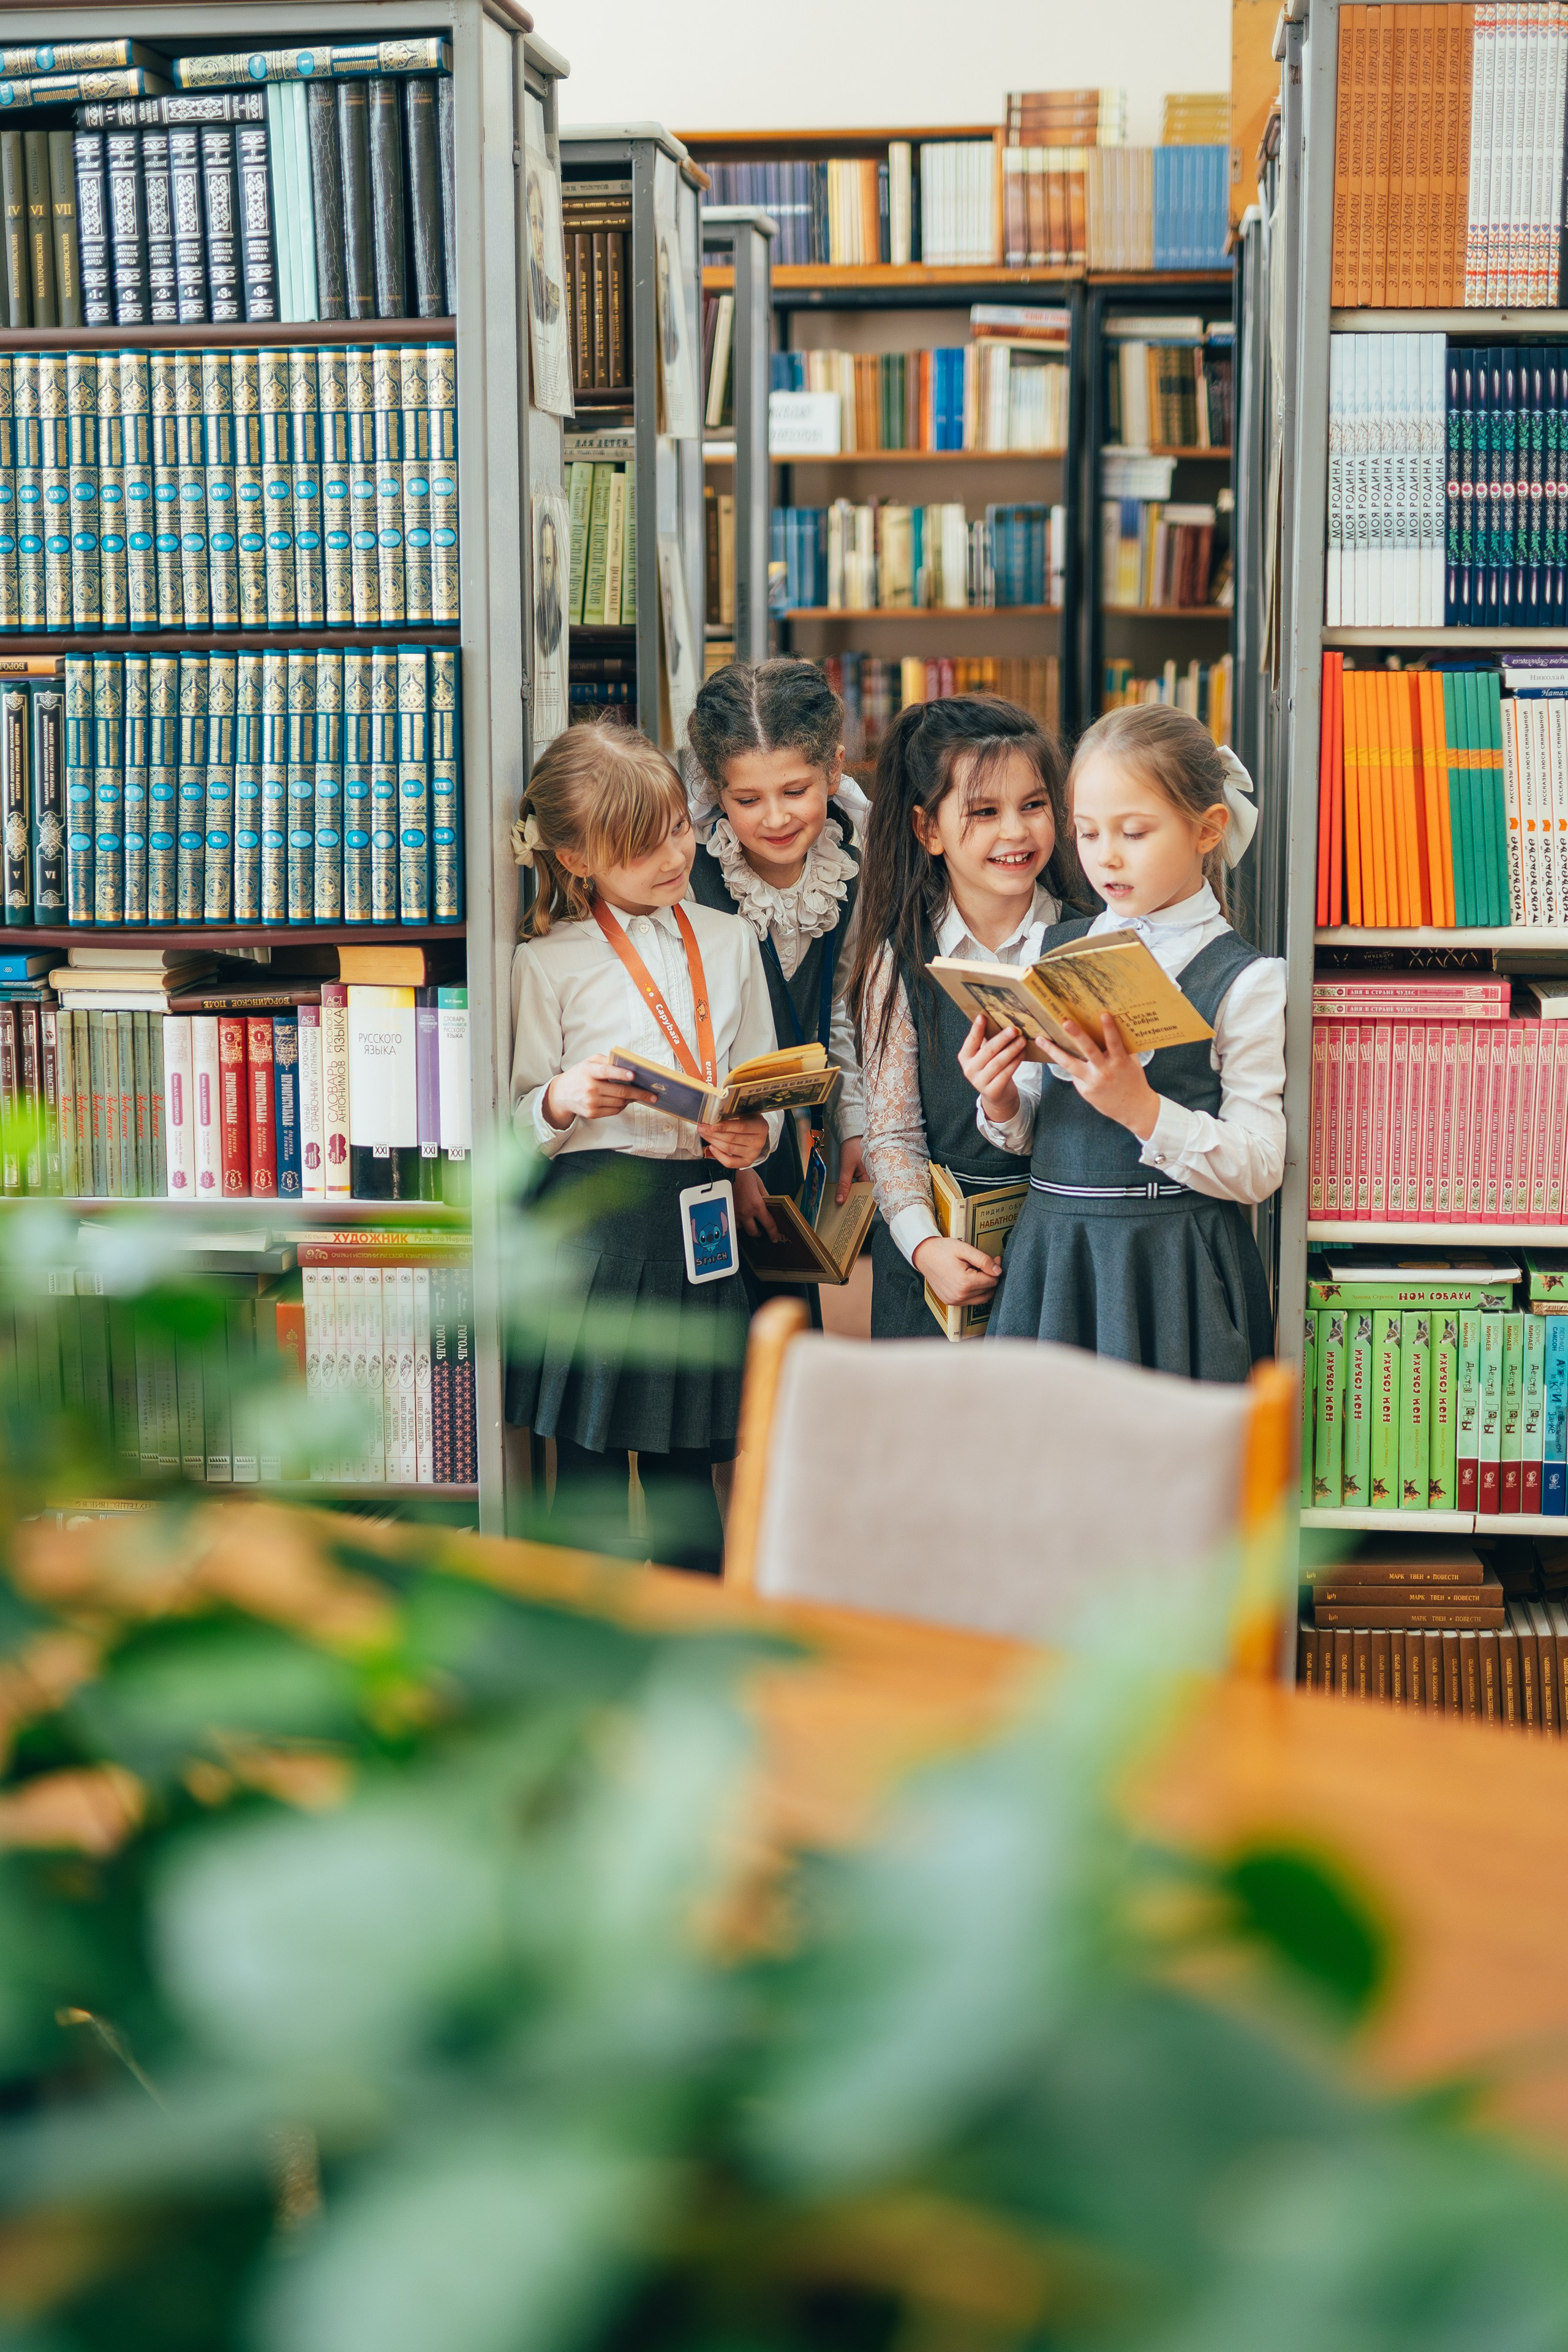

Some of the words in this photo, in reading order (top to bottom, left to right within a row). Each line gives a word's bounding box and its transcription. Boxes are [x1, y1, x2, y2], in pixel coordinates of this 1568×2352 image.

[1341, 28, 1352, 86] НЕВЕСТА
[1395, 28, 1405, 86] НЕВЕСТА
[1475, 49, 1483, 86] СКАЗКИ
[1473, 89, 1483, 149] ВОЛШЕБНЫЕ
[1338, 92, 1351, 178] КОРОЛЕВСКАЯ
[1392, 92, 1405, 178] КОРОЛЕВСКАЯ
[7, 205, 21, 216] IV
[31, 205, 43, 216] VI
[55, 204, 72, 215] VII
[1332, 459, 1342, 508] РОДИНА
[1359, 459, 1368, 509] РОДИНА
[1384, 458, 1393, 507] РОДИНА
[1332, 513, 1341, 538] МОЯ
[1384, 512, 1392, 537] МОЯ
[12, 870, 20, 879] V
[45, 870, 56, 879] VI
[203, 1000, 226, 1009] ПОЛЕ
[232, 996, 290, 1007] БОРОДИНСКОЕ
[334, 1008, 344, 1052] ЯЗЫКА
[359, 1033, 402, 1044] РУССКОГО
[655, 1003, 680, 1045] Capybara
[364, 1044, 396, 1055] ЯЗЫКА
[303, 1071, 309, 1081] ПО
[311, 1079, 319, 1132] СПРАВОЧНИК
[327, 1061, 338, 1123] СЛОВАРЬ
[337, 1060, 346, 1123] АНТОНИМОВ
[423, 1146, 435, 1155] XXI
[980, 1207, 1005, 1217] ЛИДИЯ
[333, 1233, 408, 1244] ХУДОЖНИК
[696, 1251, 728, 1266] STITCH
[435, 1324, 446, 1360] ГОГОЛЬ
[458, 1324, 468, 1360] ГОГОЛЬ
